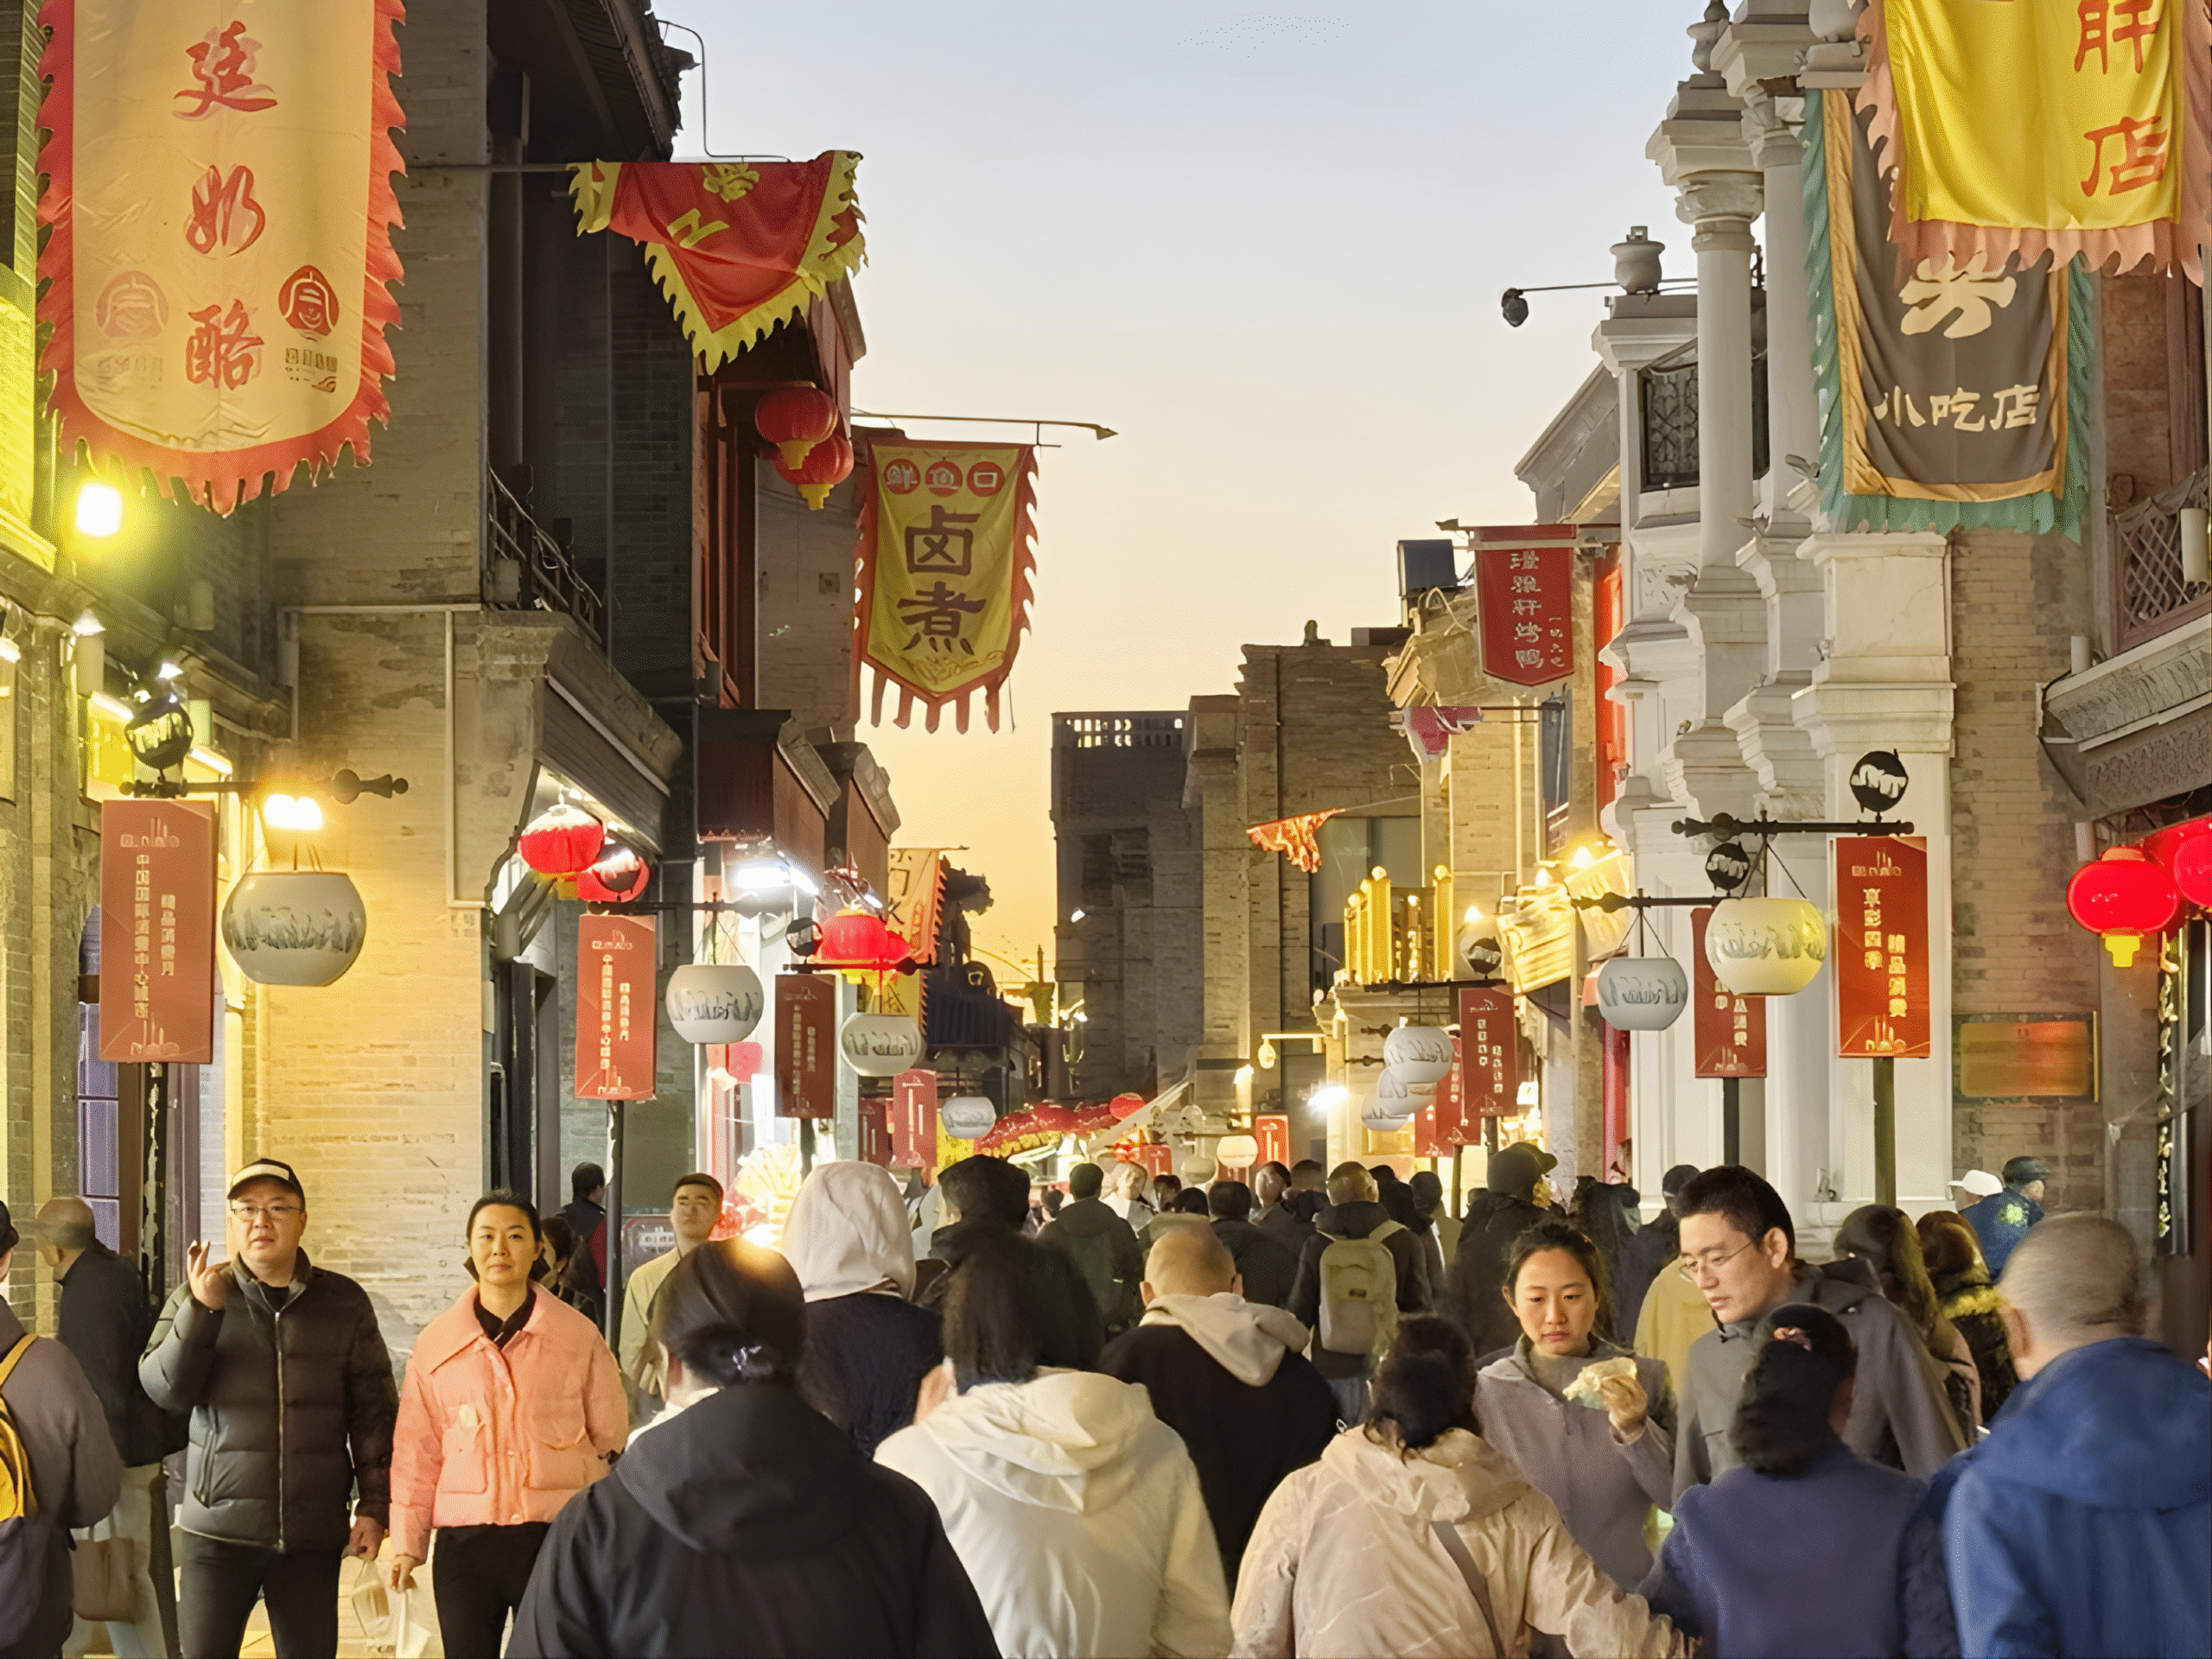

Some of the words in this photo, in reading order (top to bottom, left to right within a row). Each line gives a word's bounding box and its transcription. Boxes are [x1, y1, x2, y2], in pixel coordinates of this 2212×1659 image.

[2074, 0, 2168, 197] 肝店
[1873, 385, 2040, 432] 小吃店
[897, 505, 987, 656] 卤煮
